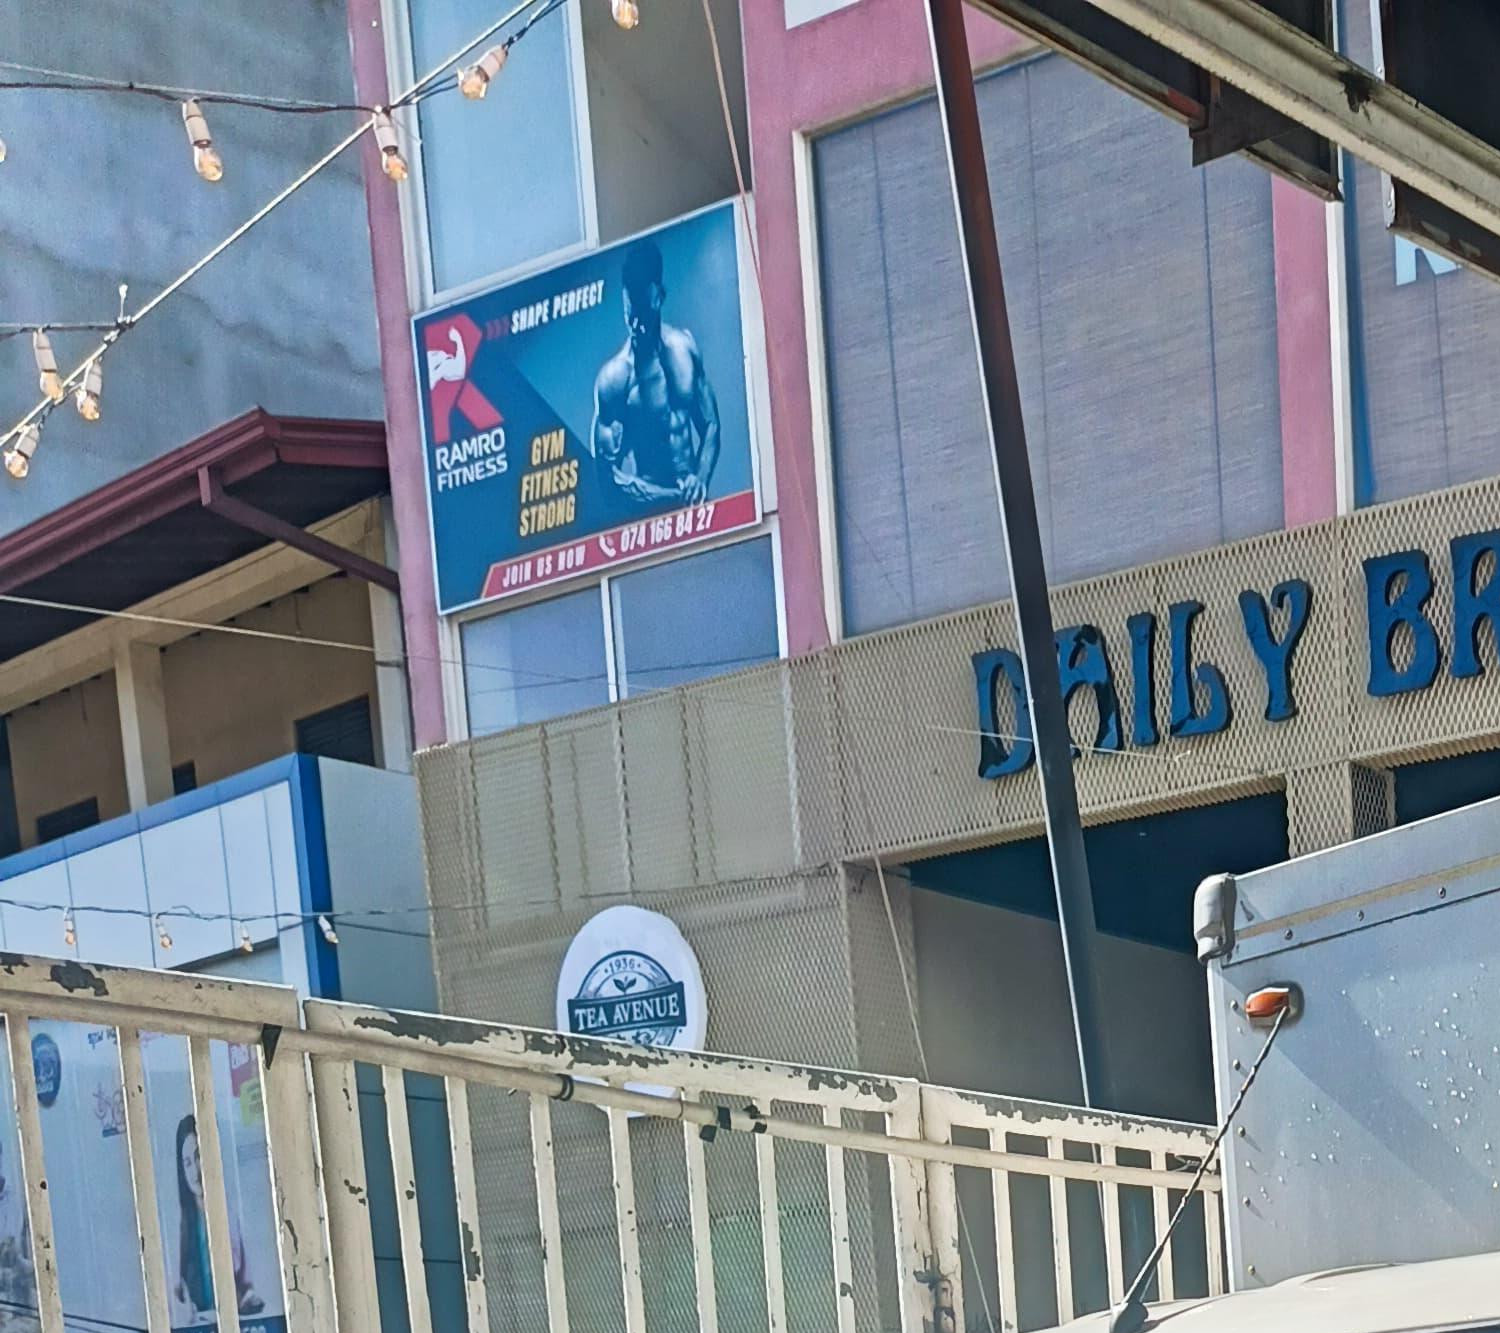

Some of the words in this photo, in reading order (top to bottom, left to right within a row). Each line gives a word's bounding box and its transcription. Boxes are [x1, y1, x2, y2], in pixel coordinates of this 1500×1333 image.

[511, 299, 549, 335] SHAPE
[552, 279, 604, 319] PERFECT
[435, 426, 506, 471] RAMRO
[531, 428, 565, 466] GYM
[437, 453, 508, 493] FITNESS
[520, 459, 579, 504] FITNESS
[519, 494, 576, 537] STRONG
[620, 527, 646, 553] 074
[650, 516, 673, 545] 166
[676, 511, 693, 538] 84
[696, 503, 715, 532] 27
[502, 558, 531, 588] JOIN
[536, 553, 552, 579] US
[557, 544, 586, 572] NOW
[970, 578, 1314, 781] DAILY
[609, 957, 636, 973] 1936
[574, 1006, 608, 1032] TEA
[612, 993, 680, 1025] AVENUE
